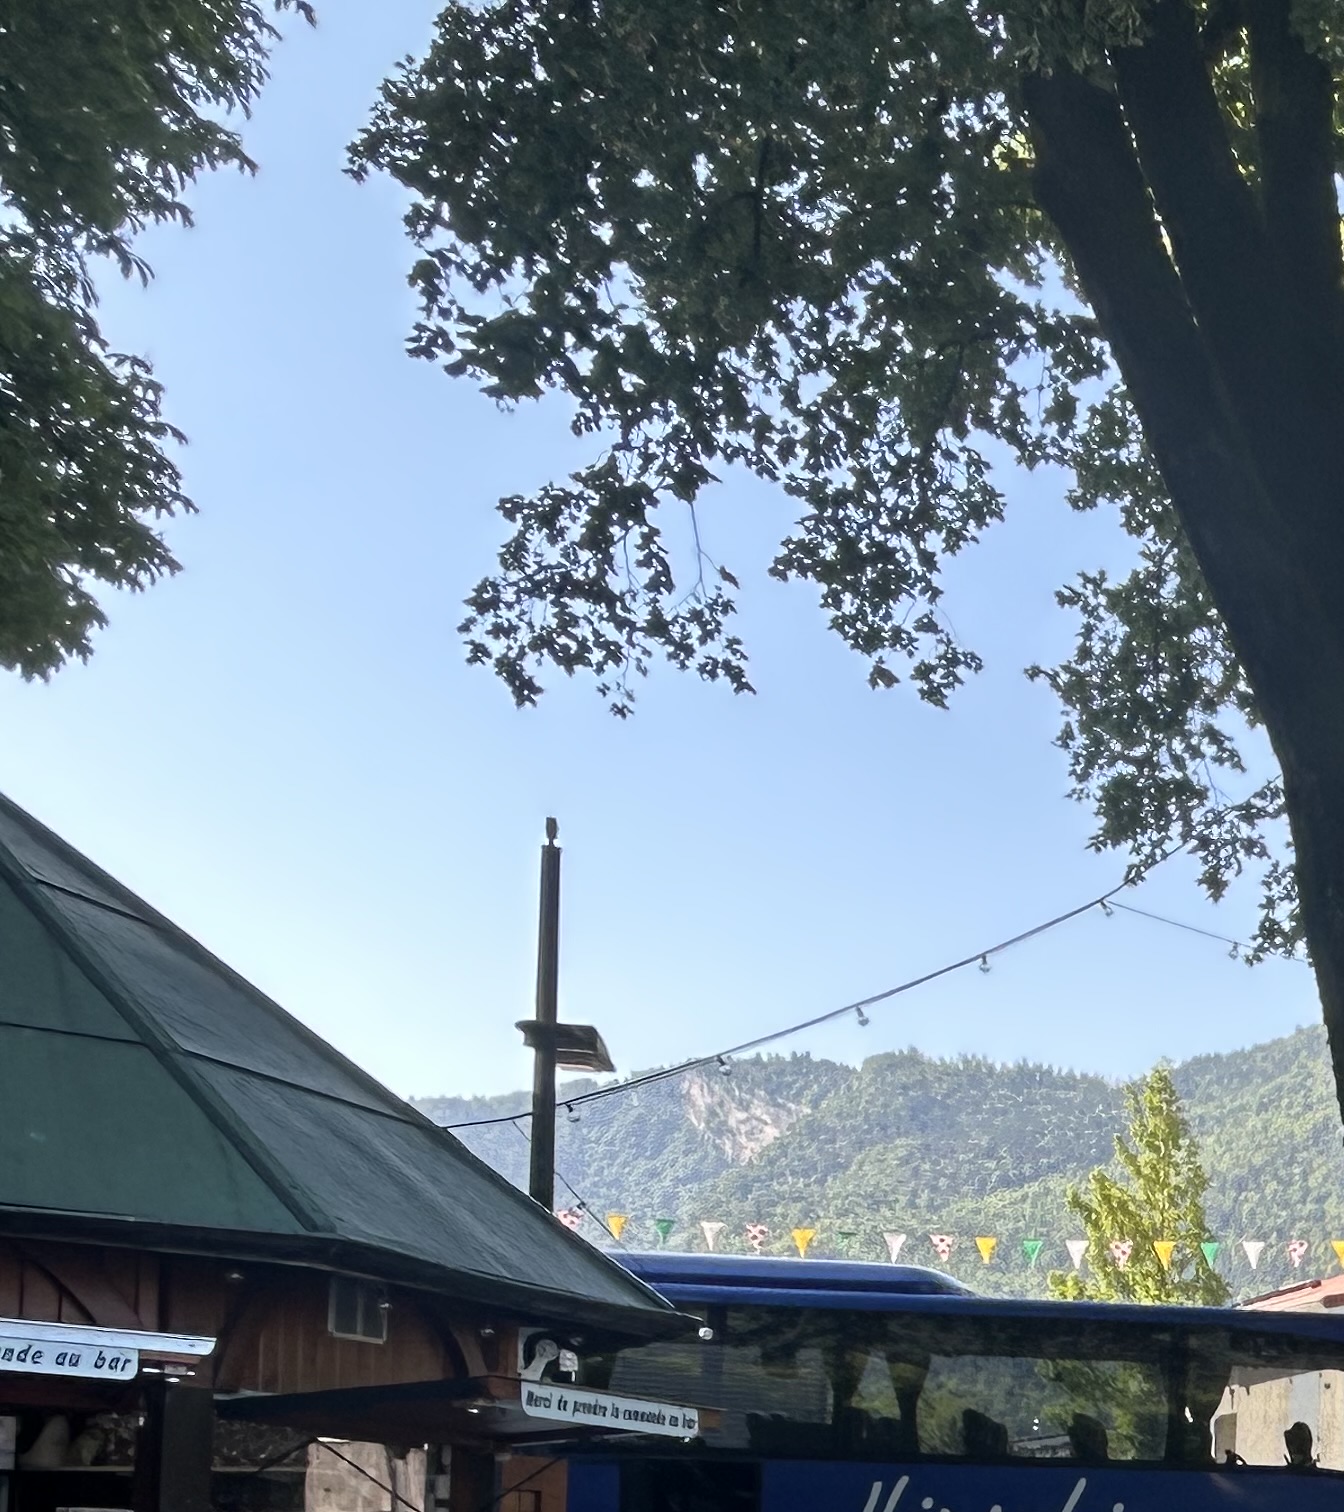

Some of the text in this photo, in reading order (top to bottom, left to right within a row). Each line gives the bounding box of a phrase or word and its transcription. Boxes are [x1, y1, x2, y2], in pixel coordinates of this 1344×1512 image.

[0, 1344, 133, 1373] nde au bar
